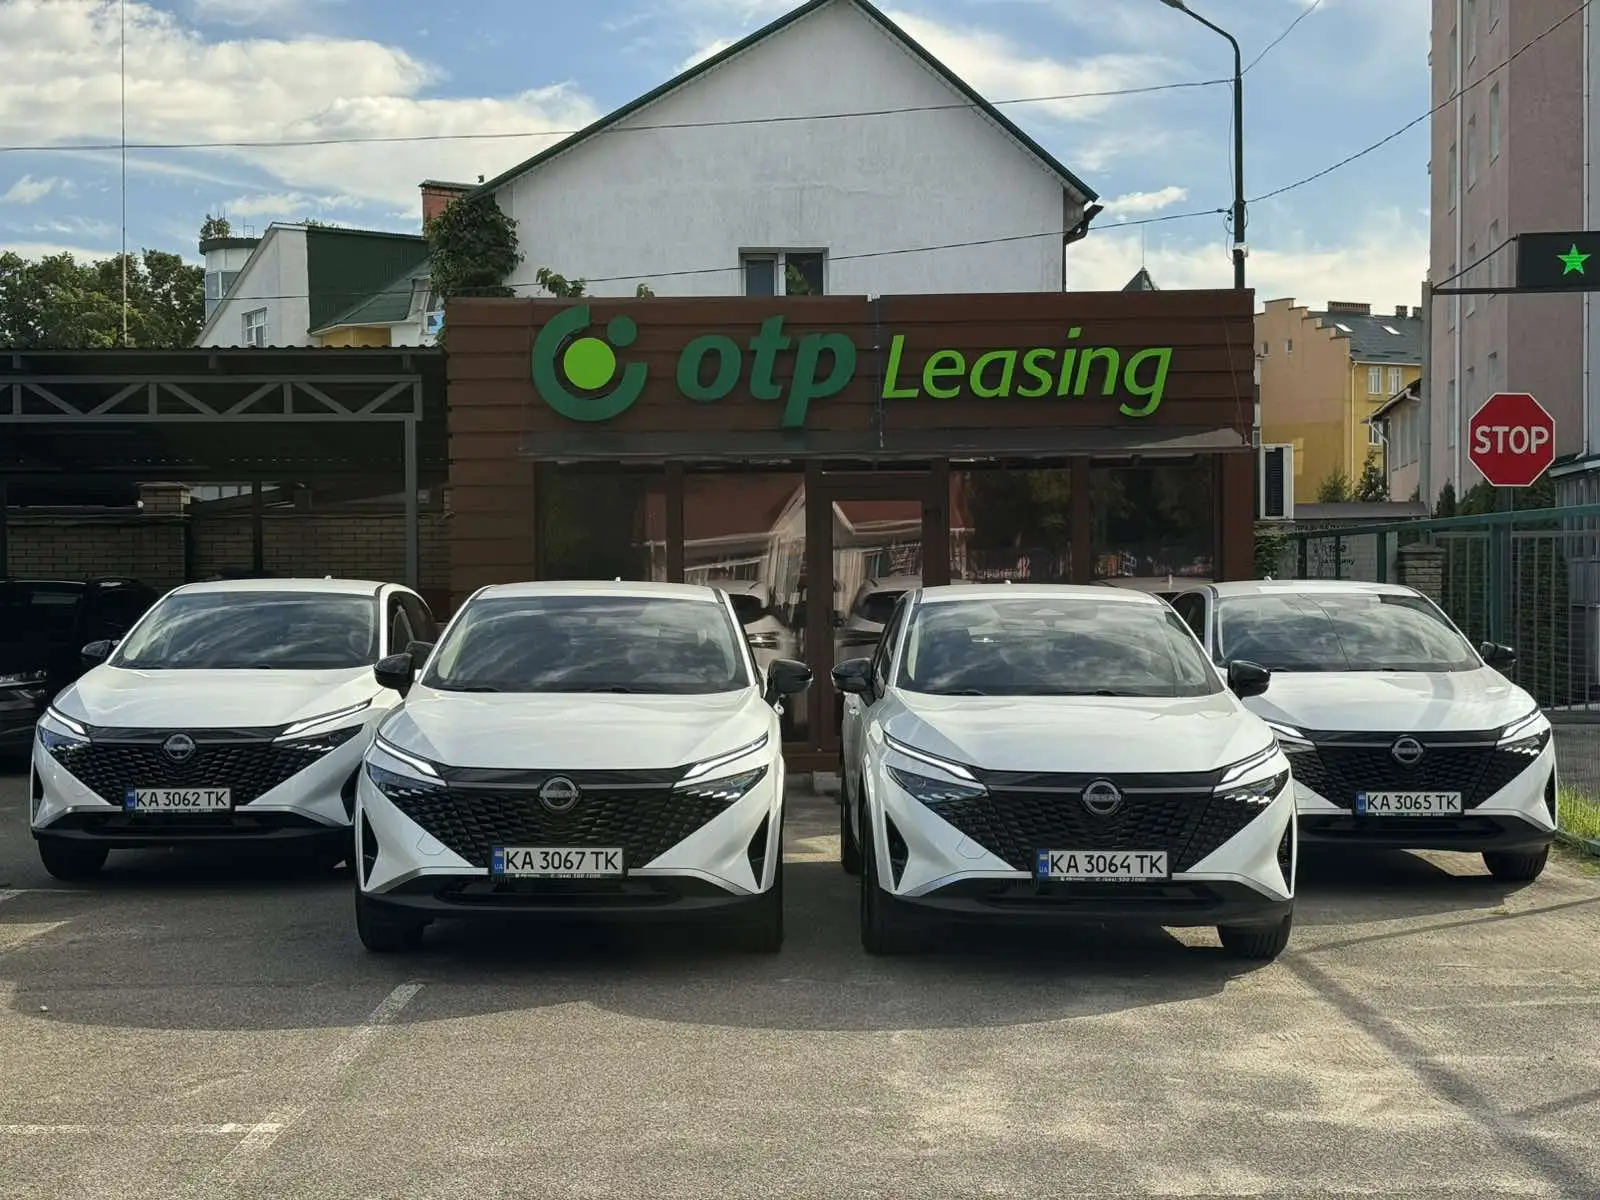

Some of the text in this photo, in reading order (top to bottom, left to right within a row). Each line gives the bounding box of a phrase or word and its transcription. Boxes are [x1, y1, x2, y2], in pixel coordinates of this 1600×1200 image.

[676, 315, 1173, 428] otp Leasing
[1474, 425, 1549, 454] STOP
[136, 792, 227, 807] KA 3062 TK
[1367, 795, 1458, 810] KA 3065 TK
[506, 851, 618, 870] KA 3067 TK
[1050, 855, 1163, 874] KA 3064 TK
